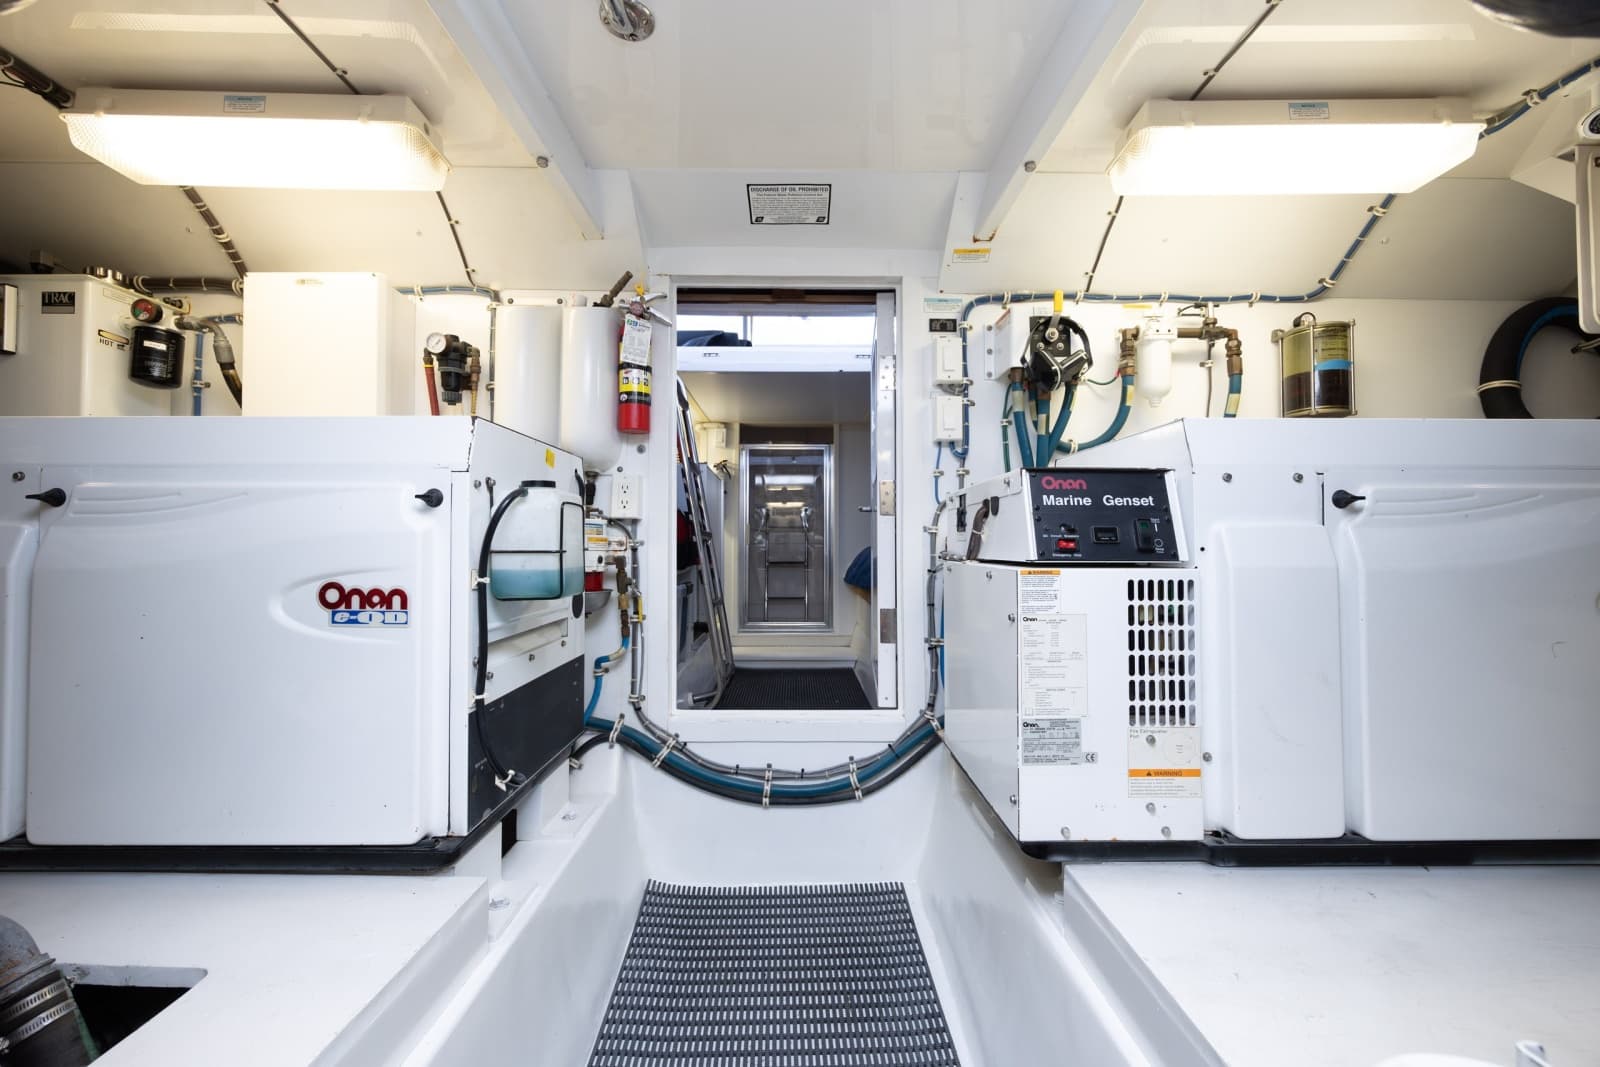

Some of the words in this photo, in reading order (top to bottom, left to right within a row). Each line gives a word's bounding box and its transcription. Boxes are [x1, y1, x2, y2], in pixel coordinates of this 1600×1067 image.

[44, 292, 73, 303] TRAC
[99, 338, 114, 347] HOT
[1041, 475, 1088, 490] Onan
[1042, 494, 1092, 506] Marine
[1102, 494, 1155, 506] Genset
[319, 581, 408, 610] Onan
